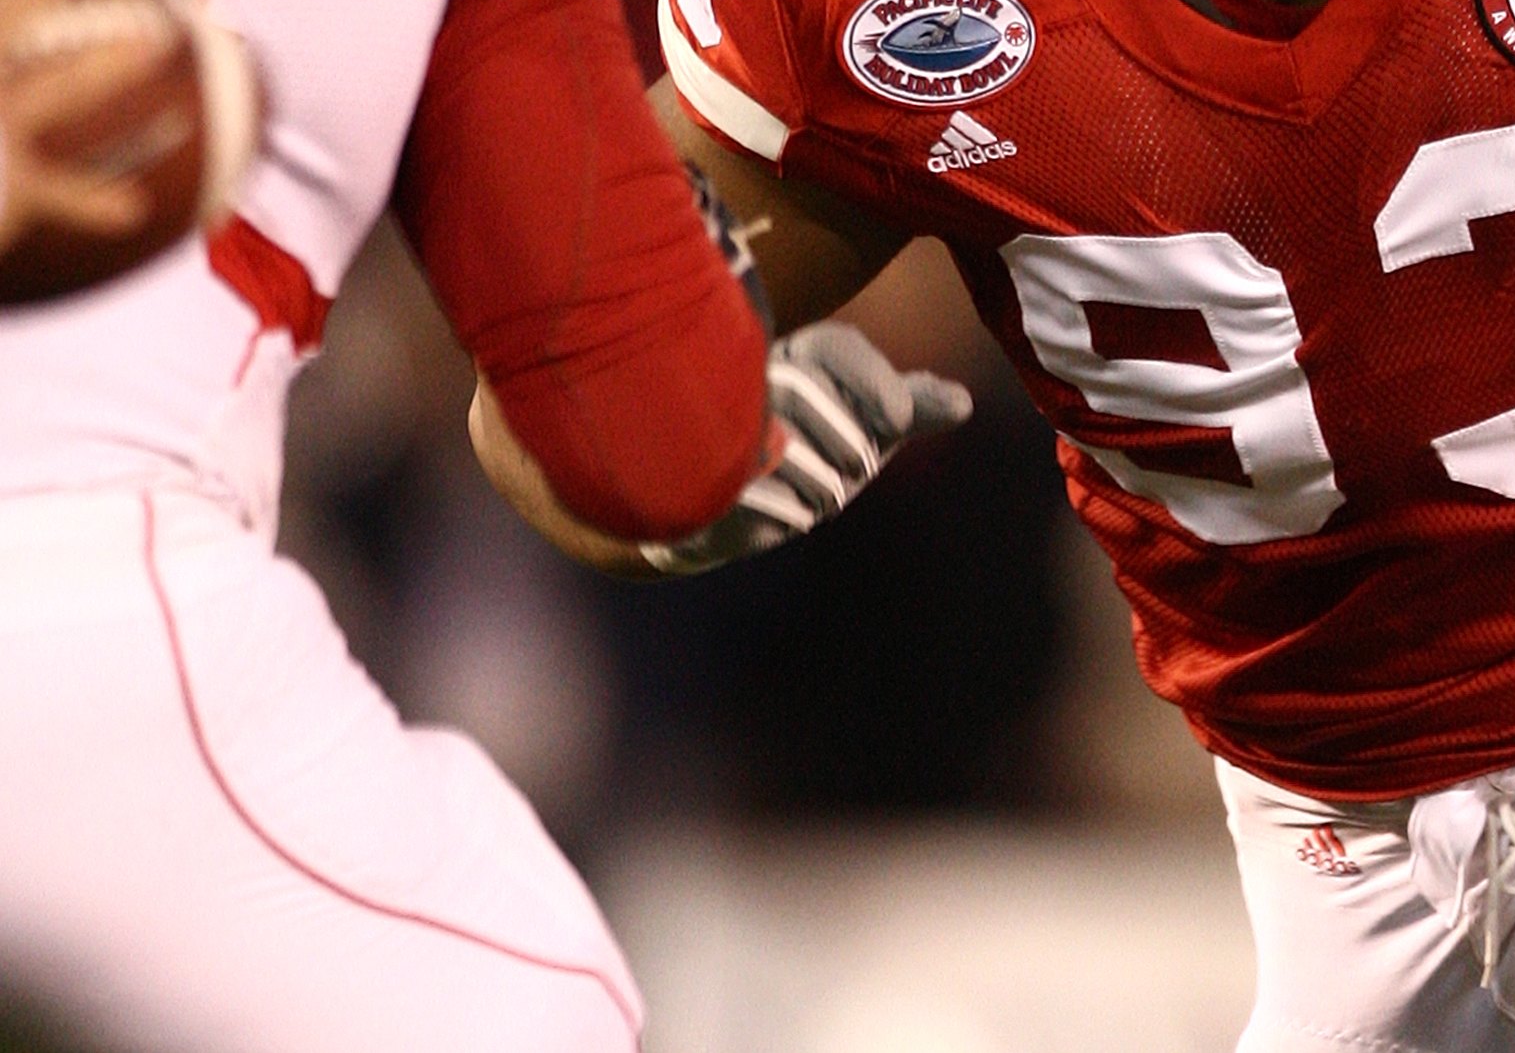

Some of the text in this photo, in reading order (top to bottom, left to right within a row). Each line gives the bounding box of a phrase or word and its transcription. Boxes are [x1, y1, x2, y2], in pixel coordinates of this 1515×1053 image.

[1491, 10, 1508, 25] A
[864, 51, 1019, 97] HOLIDAY BOWL
[927, 141, 1018, 173] adidas
